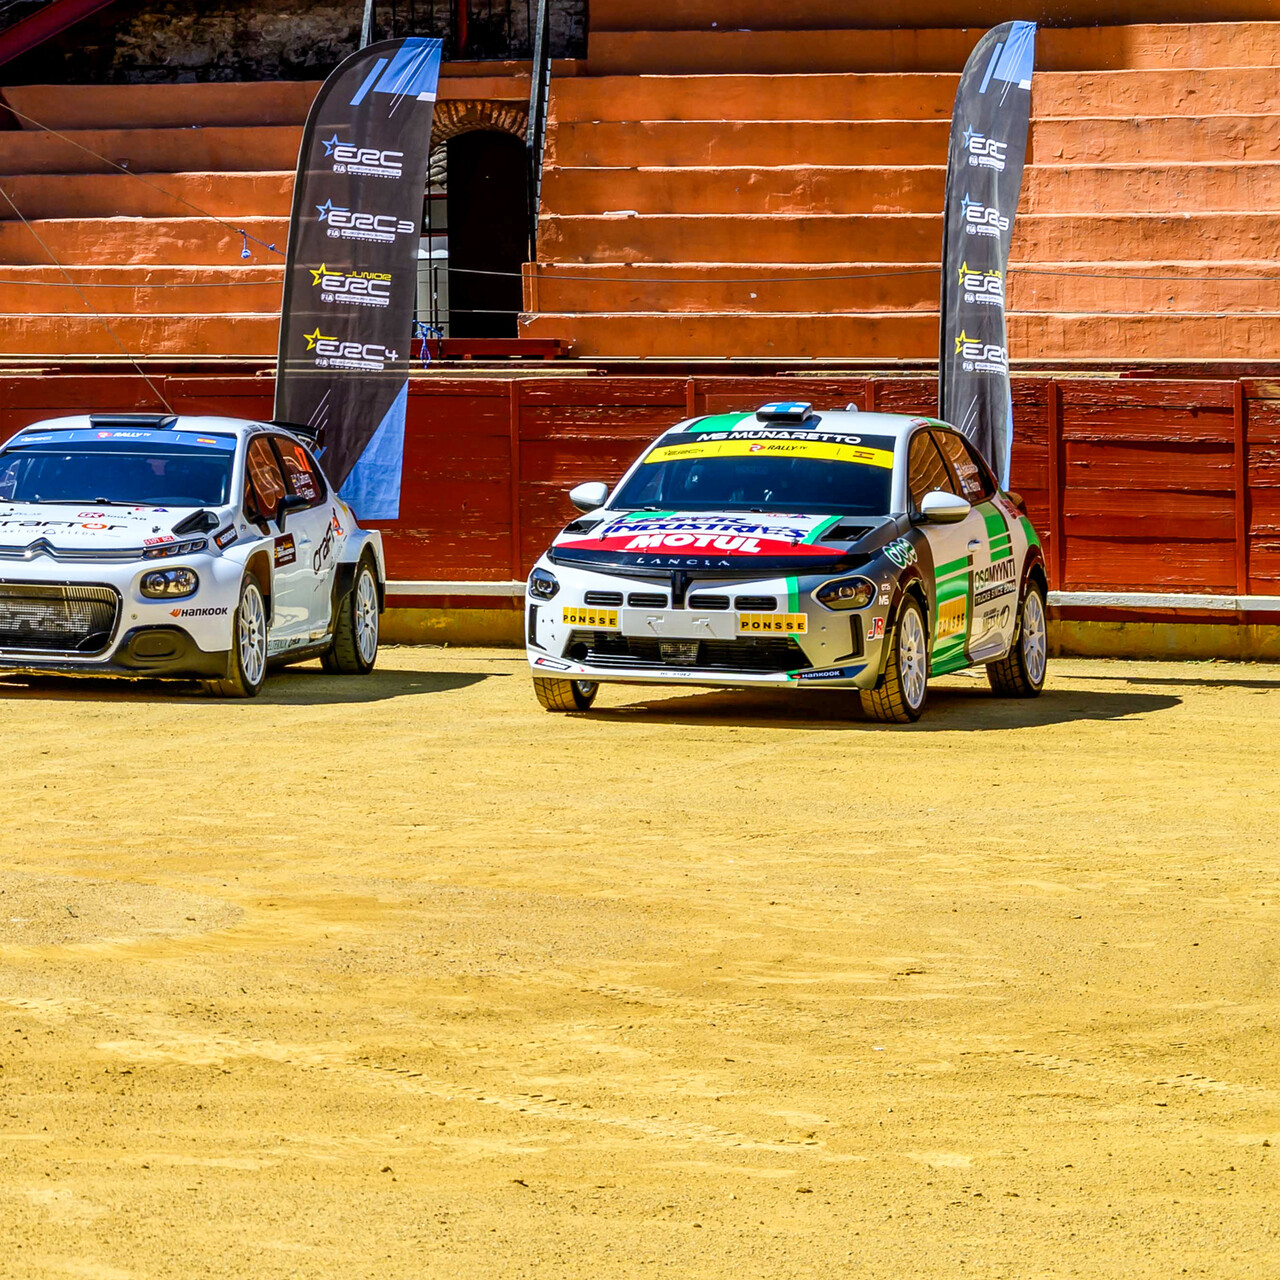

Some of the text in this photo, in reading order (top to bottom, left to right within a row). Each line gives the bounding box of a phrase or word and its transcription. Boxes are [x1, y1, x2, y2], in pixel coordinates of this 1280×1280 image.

[334, 146, 404, 167] ERC
[321, 275, 391, 296] ERC
[728, 431, 862, 444] MUNARETTO
[603, 523, 809, 539] INDUSTRIES
[624, 534, 762, 554] MOTUL
[636, 557, 730, 567] LANCIA
[564, 613, 617, 626] PONSSE
[741, 620, 805, 631] PONSSE
